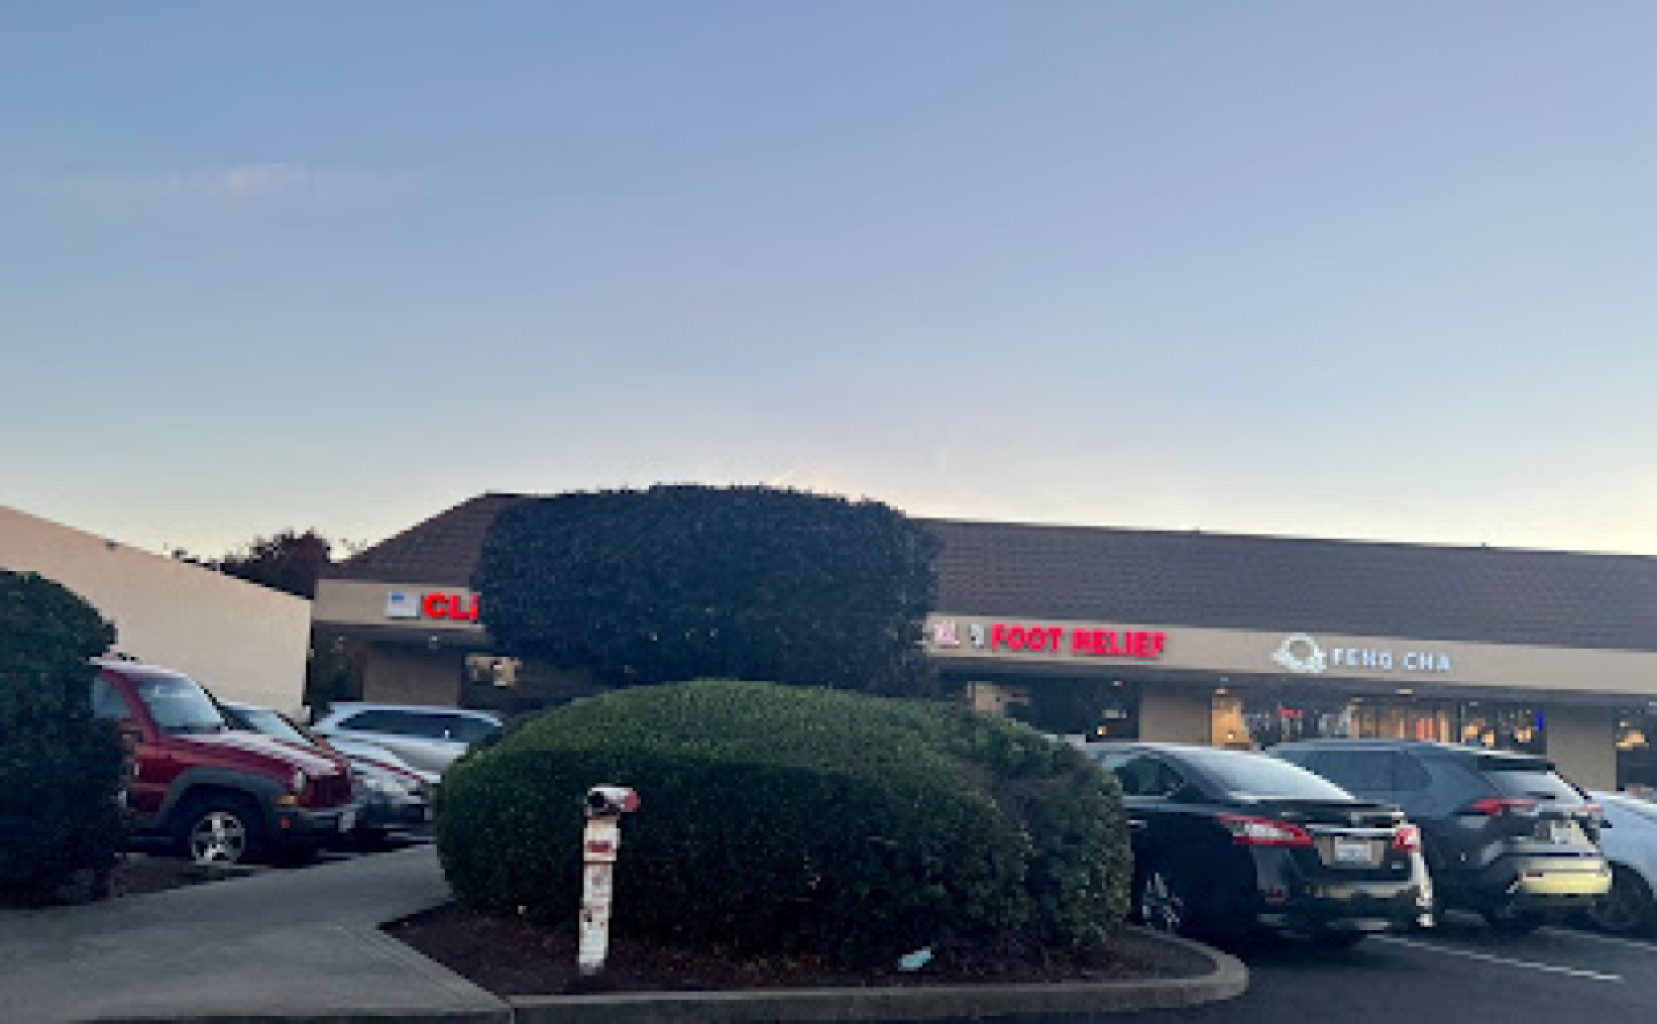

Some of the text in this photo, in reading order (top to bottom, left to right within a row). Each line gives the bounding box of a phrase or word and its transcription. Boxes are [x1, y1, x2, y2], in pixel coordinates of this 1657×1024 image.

[991, 623, 1166, 657] FOOT RELIEF
[1403, 652, 1450, 671] CHA
